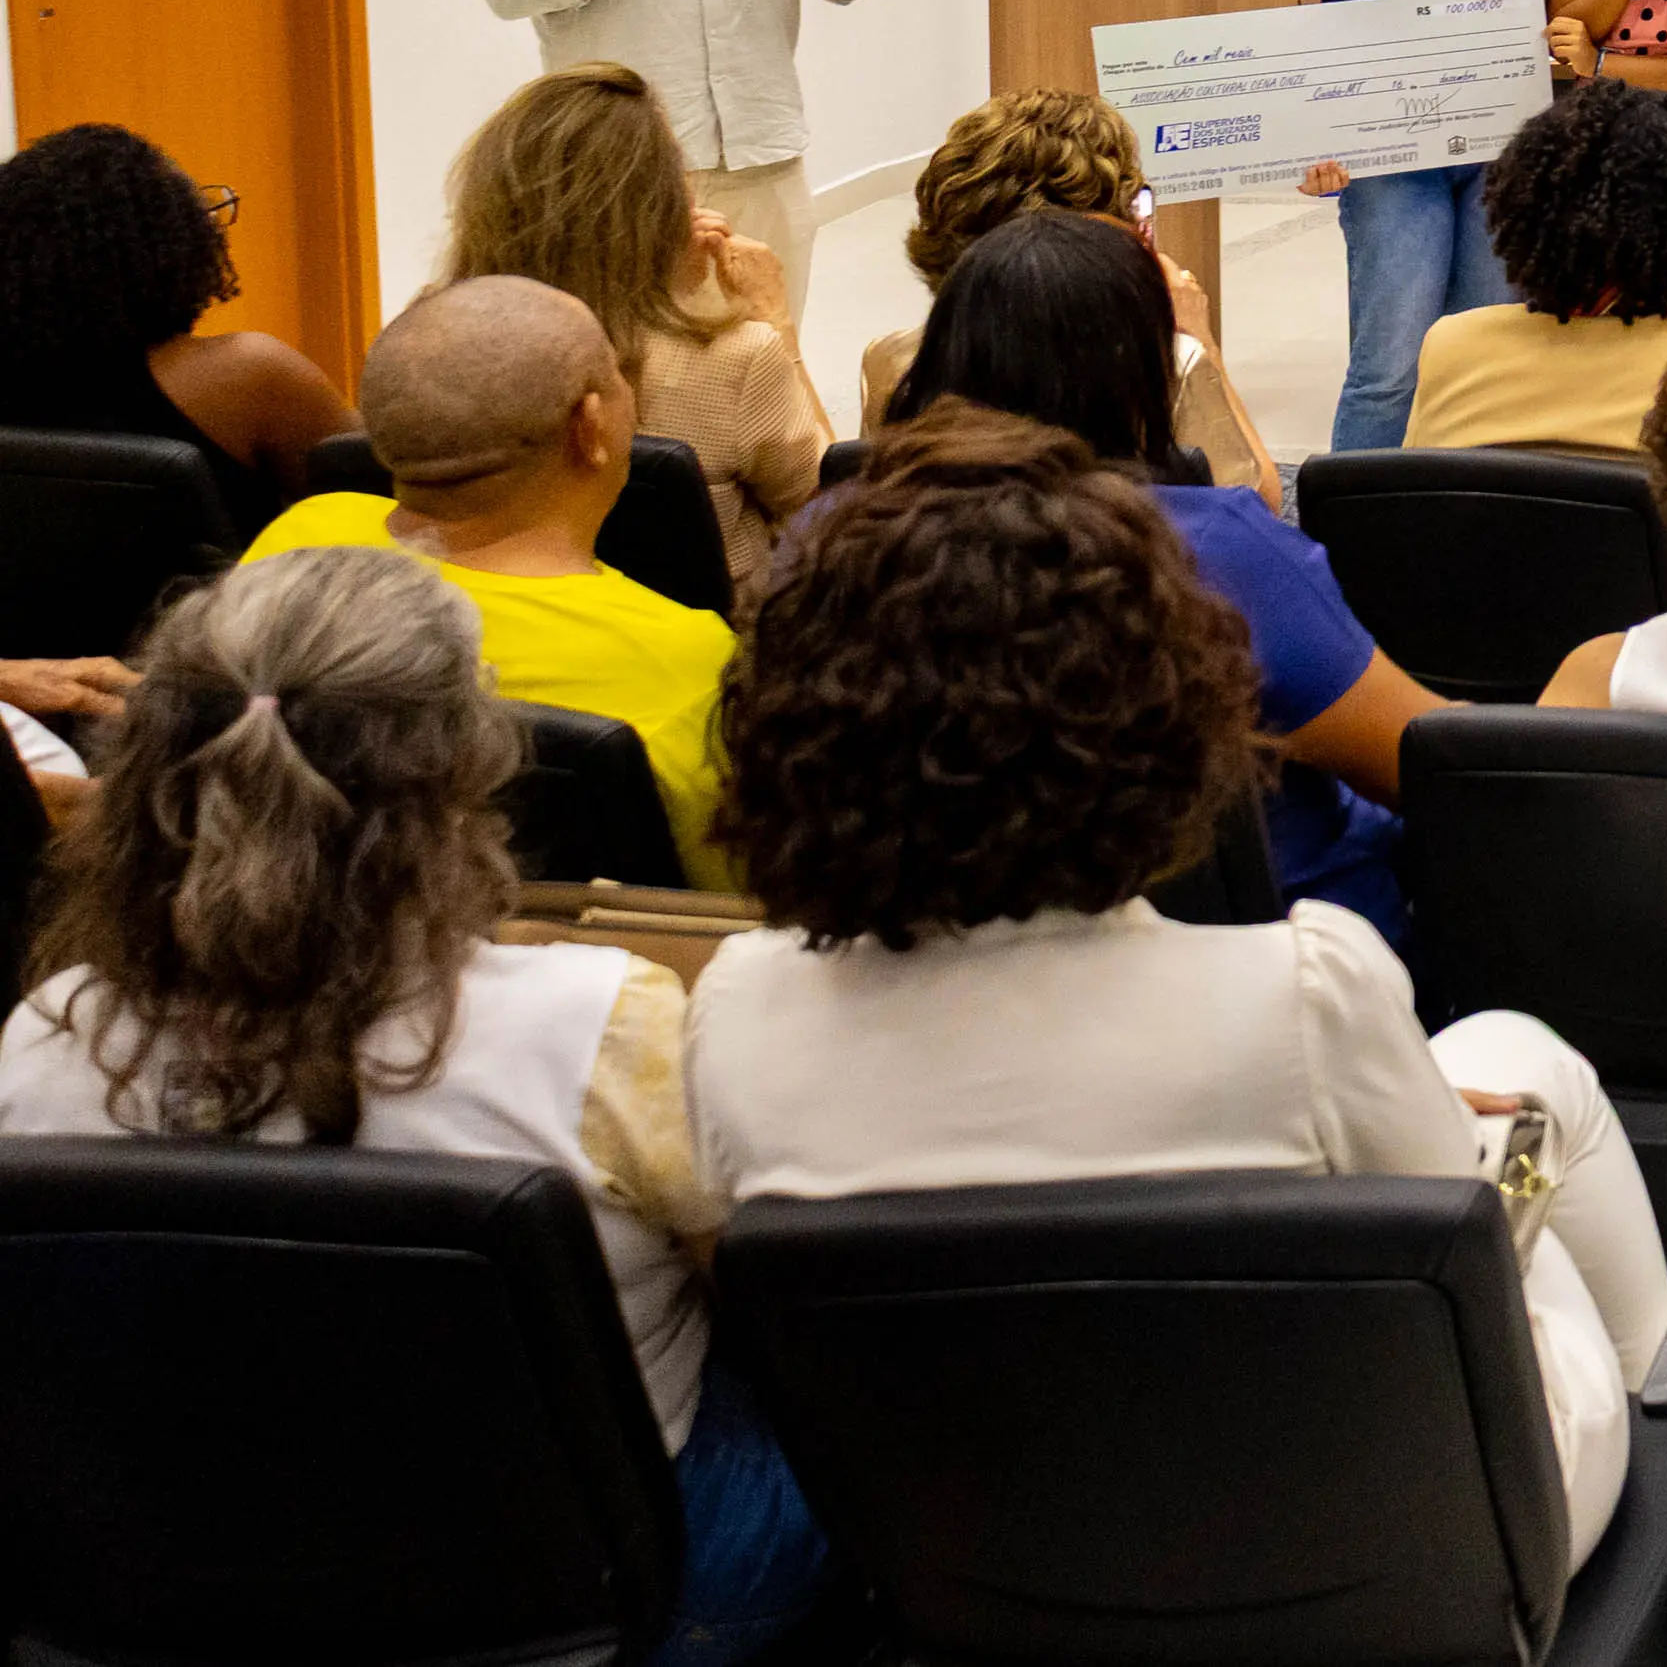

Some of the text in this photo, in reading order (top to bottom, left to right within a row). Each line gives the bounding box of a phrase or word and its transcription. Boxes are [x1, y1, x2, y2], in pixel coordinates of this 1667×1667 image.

[1193, 113, 1262, 130] SUPERVISÃO
[1192, 131, 1261, 149] ESPECIAIS
[1193, 129, 1215, 139] DOS
